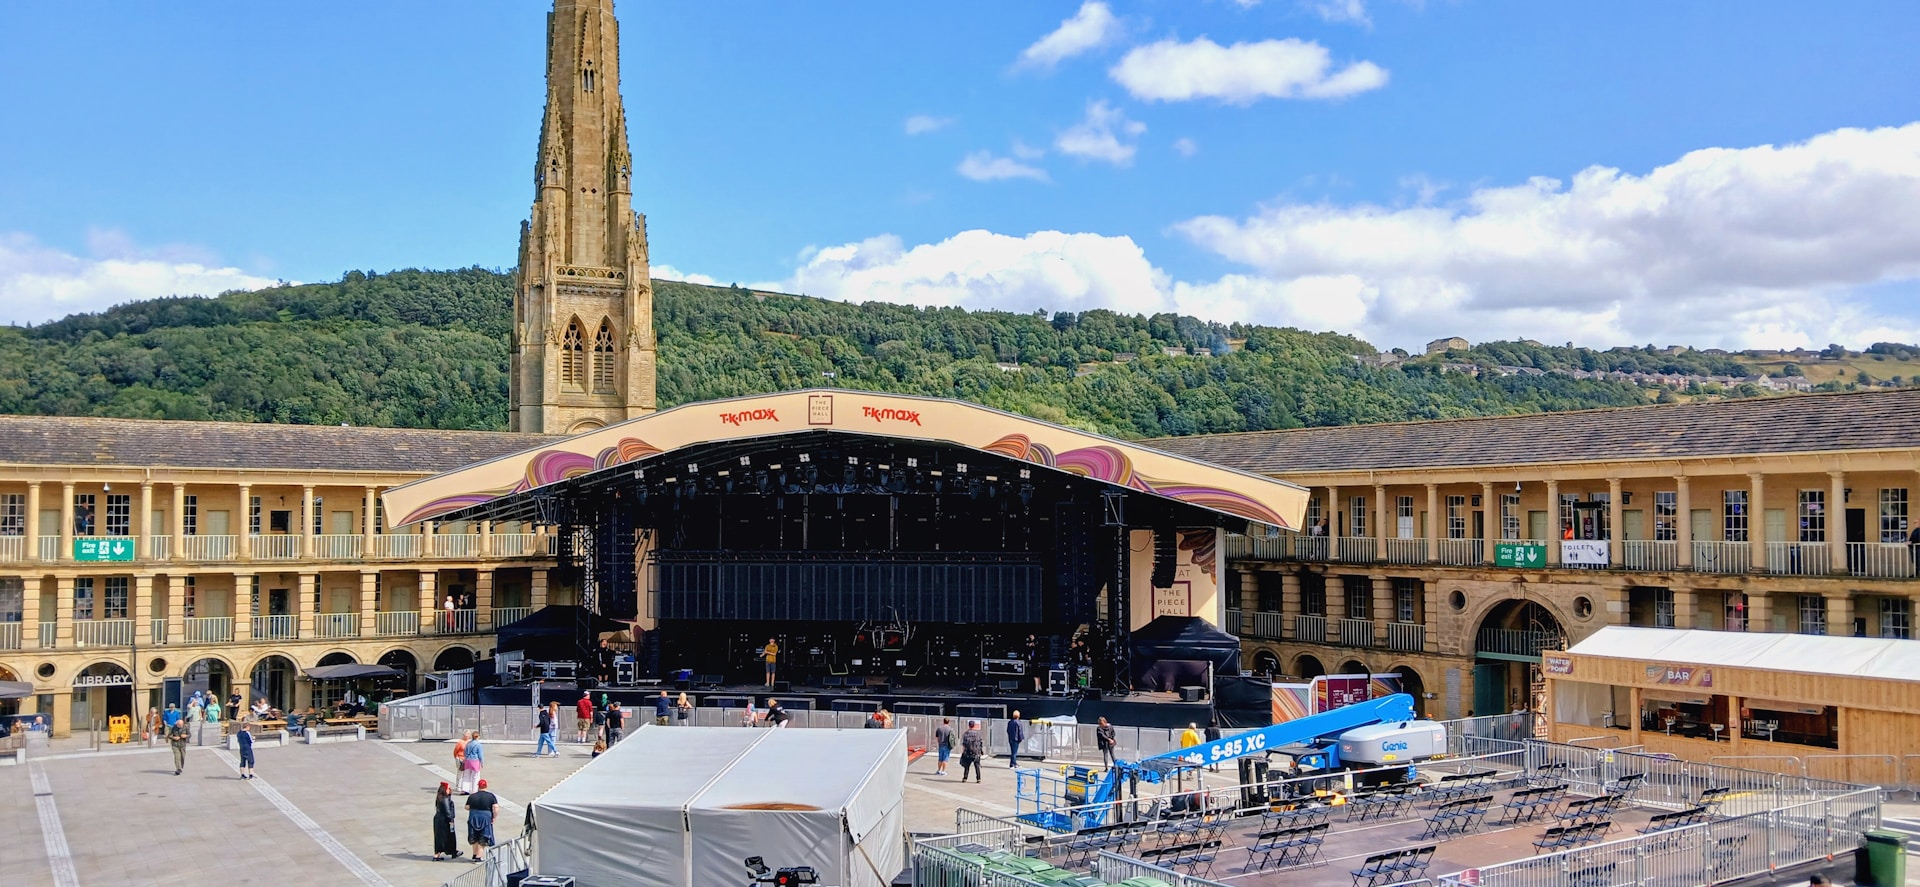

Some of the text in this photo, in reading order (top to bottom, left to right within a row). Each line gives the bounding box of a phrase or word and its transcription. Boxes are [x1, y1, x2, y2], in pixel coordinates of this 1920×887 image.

[1549, 658, 1570, 666] WATER
[1550, 665, 1568, 673] POINT
[75, 675, 129, 685] LIBRARY
[1667, 670, 1690, 681] BAR
[1211, 733, 1266, 761] S-85 XC
[1382, 741, 1408, 752] Genie
